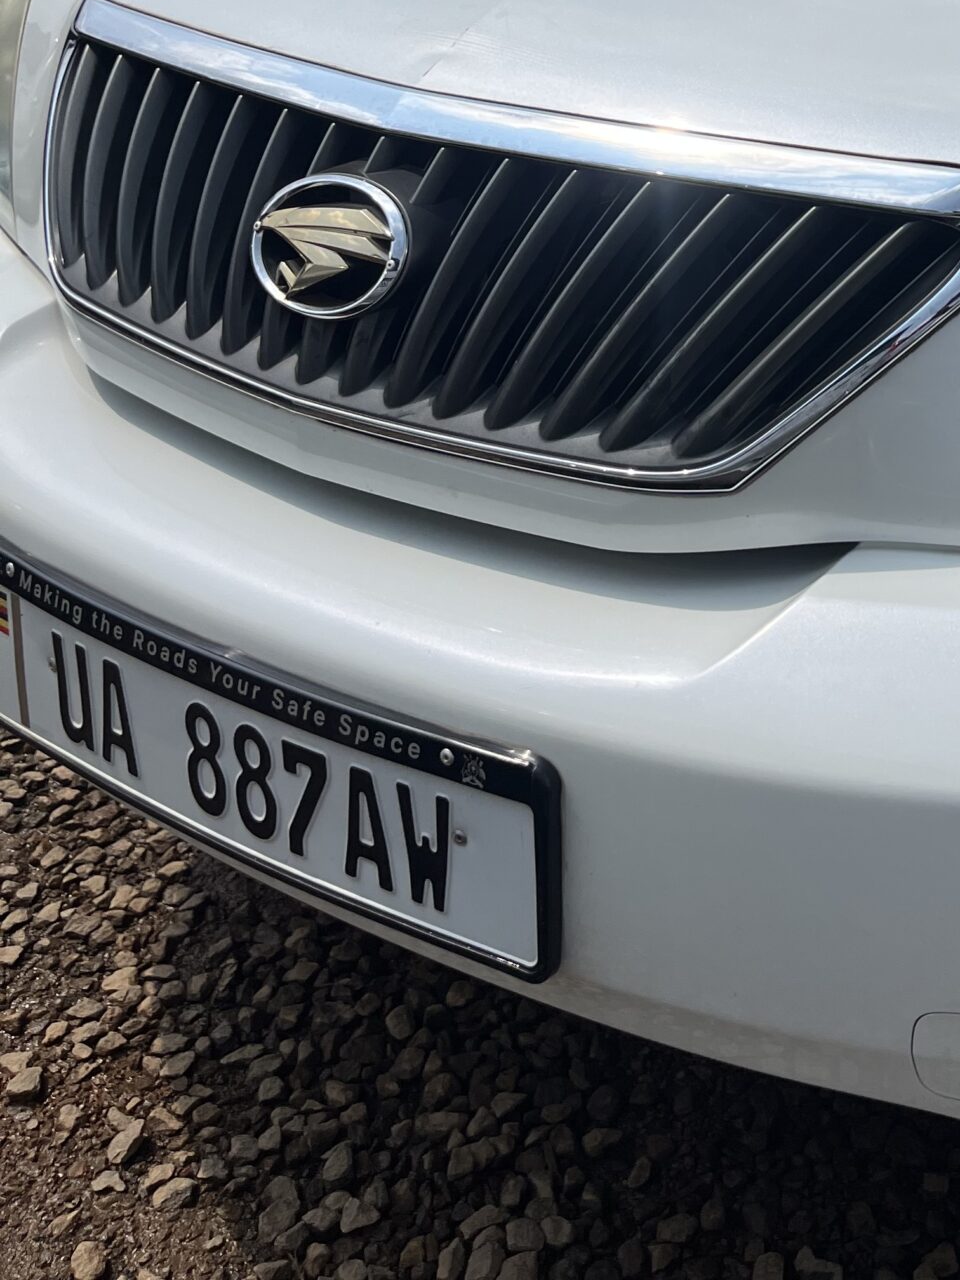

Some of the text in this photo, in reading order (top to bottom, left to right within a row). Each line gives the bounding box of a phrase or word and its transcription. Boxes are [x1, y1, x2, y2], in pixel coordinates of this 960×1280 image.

[19, 569, 421, 761] Making the Roads Your Safe Space
[51, 630, 140, 778] UA
